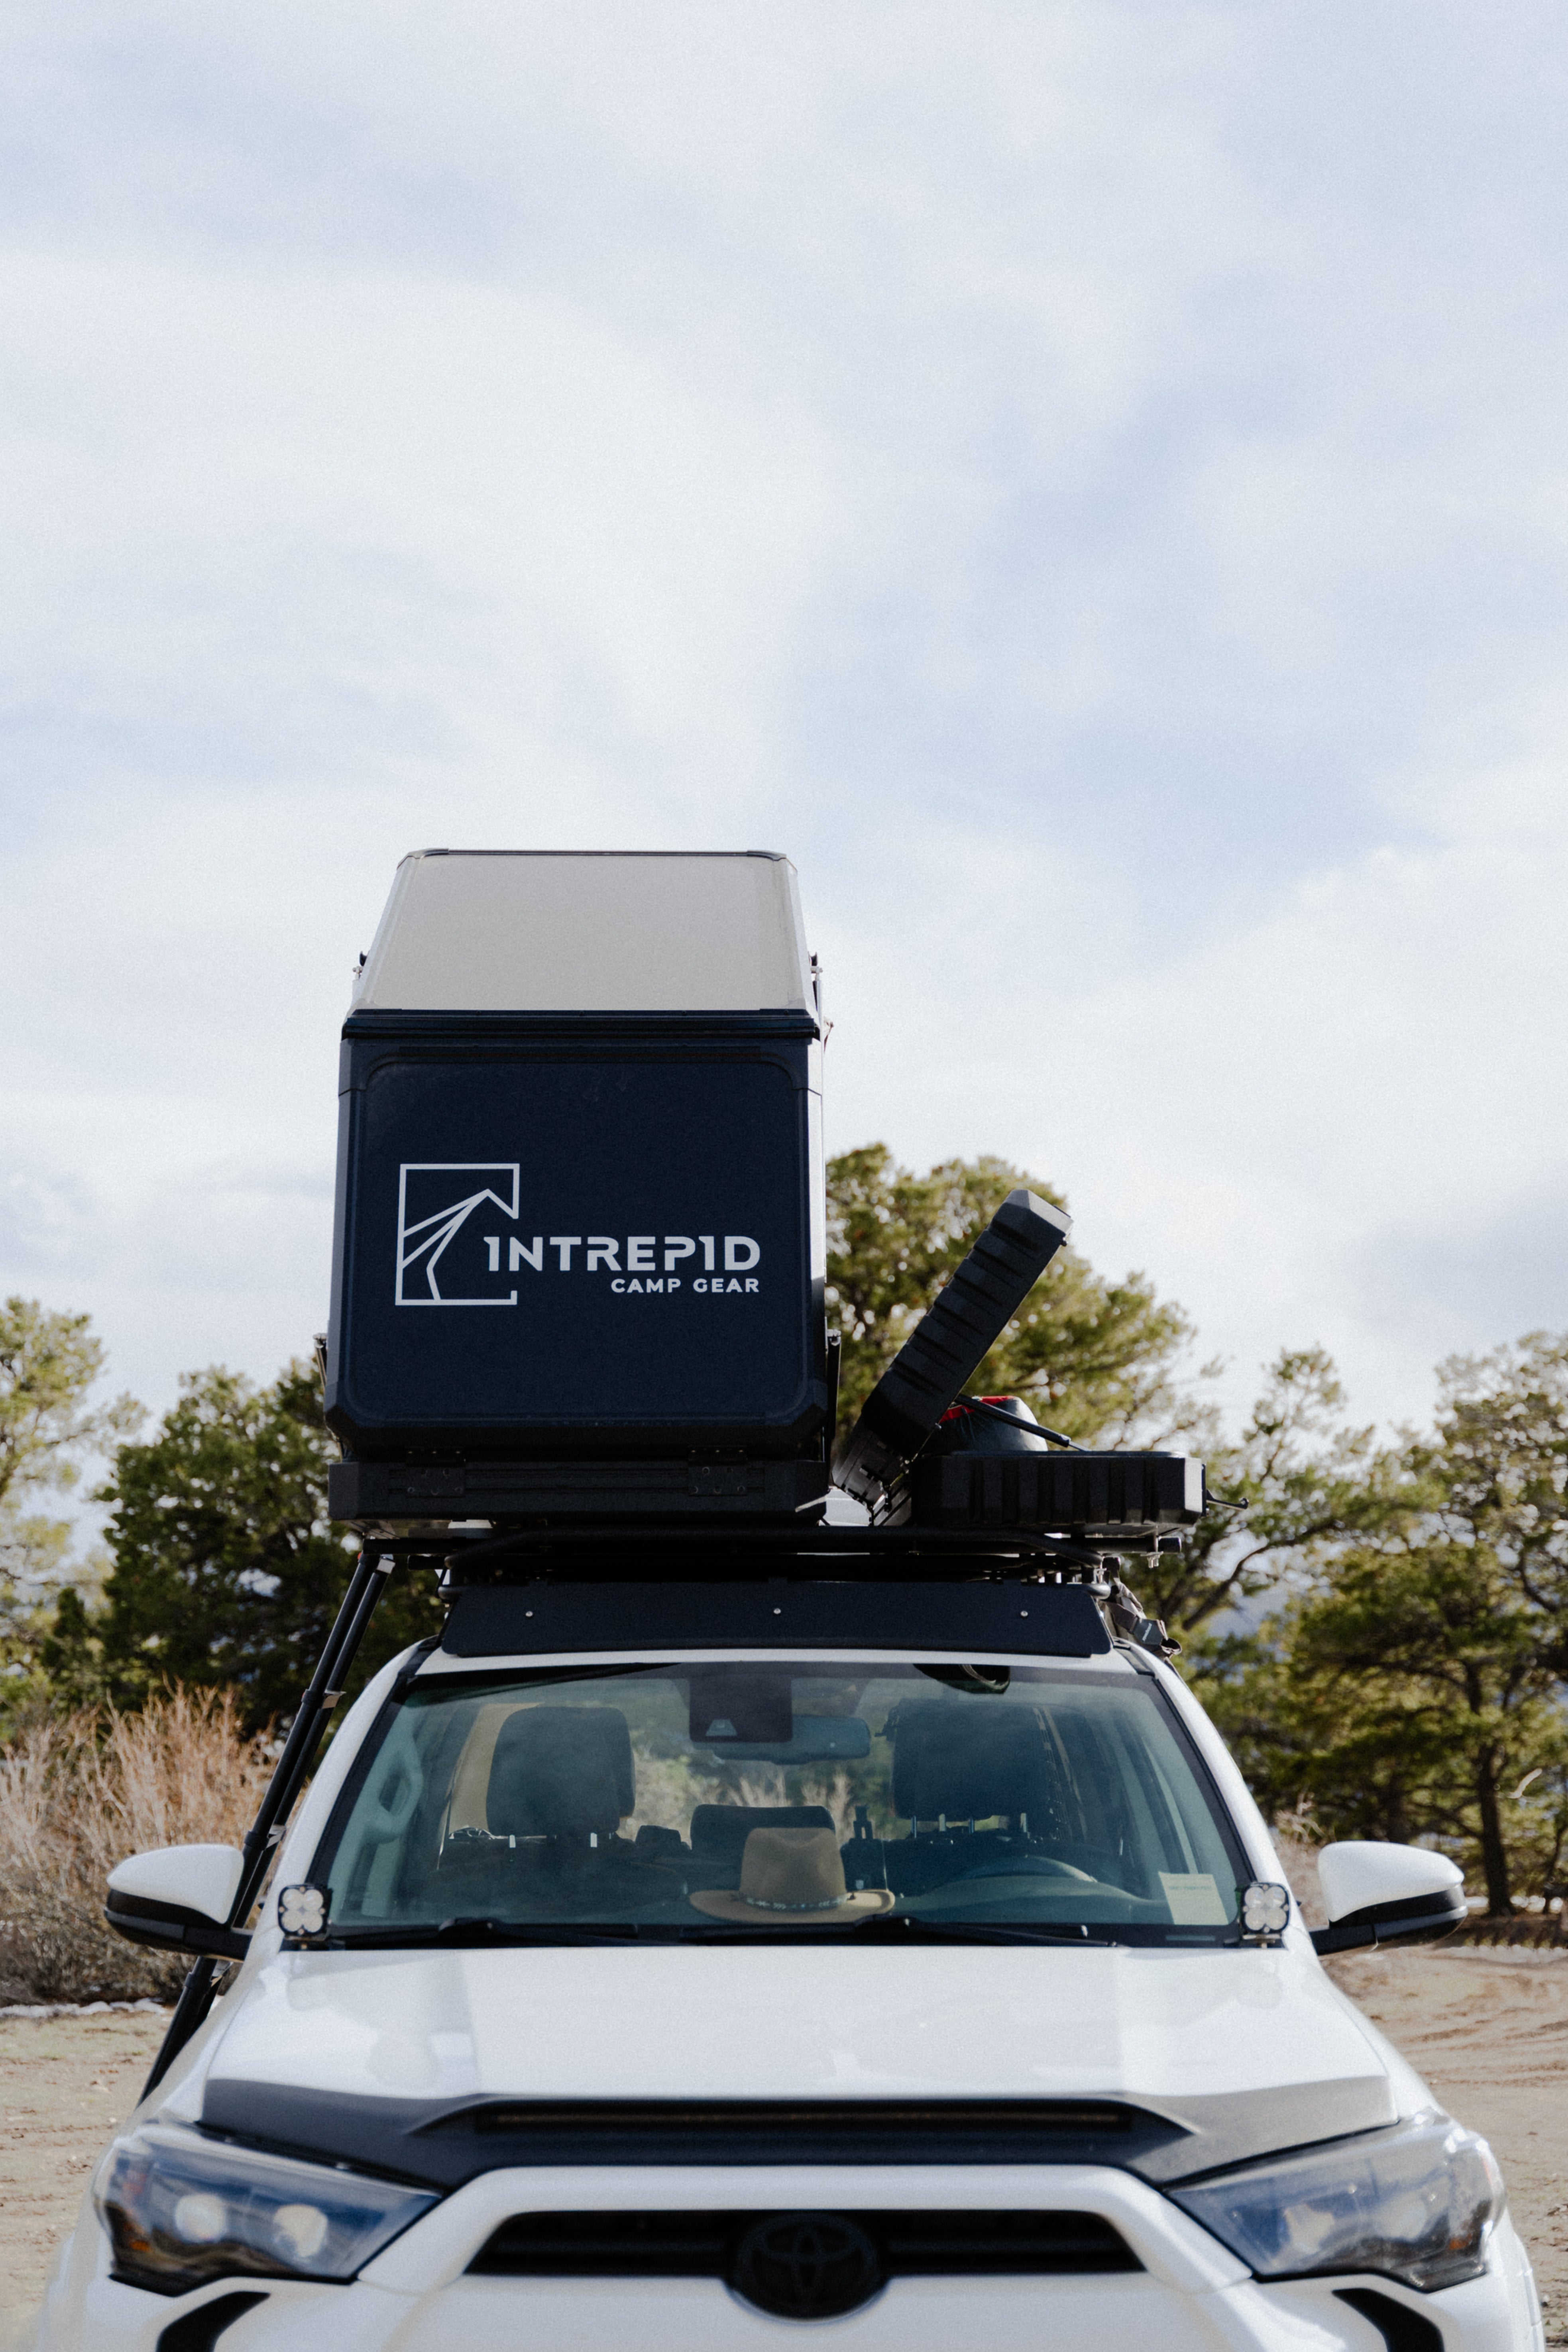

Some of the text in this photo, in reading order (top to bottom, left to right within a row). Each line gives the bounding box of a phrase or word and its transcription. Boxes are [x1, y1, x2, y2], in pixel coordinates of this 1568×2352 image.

[483, 1236, 760, 1271] INTREPID
[611, 1278, 759, 1293] CAMP GEAR
